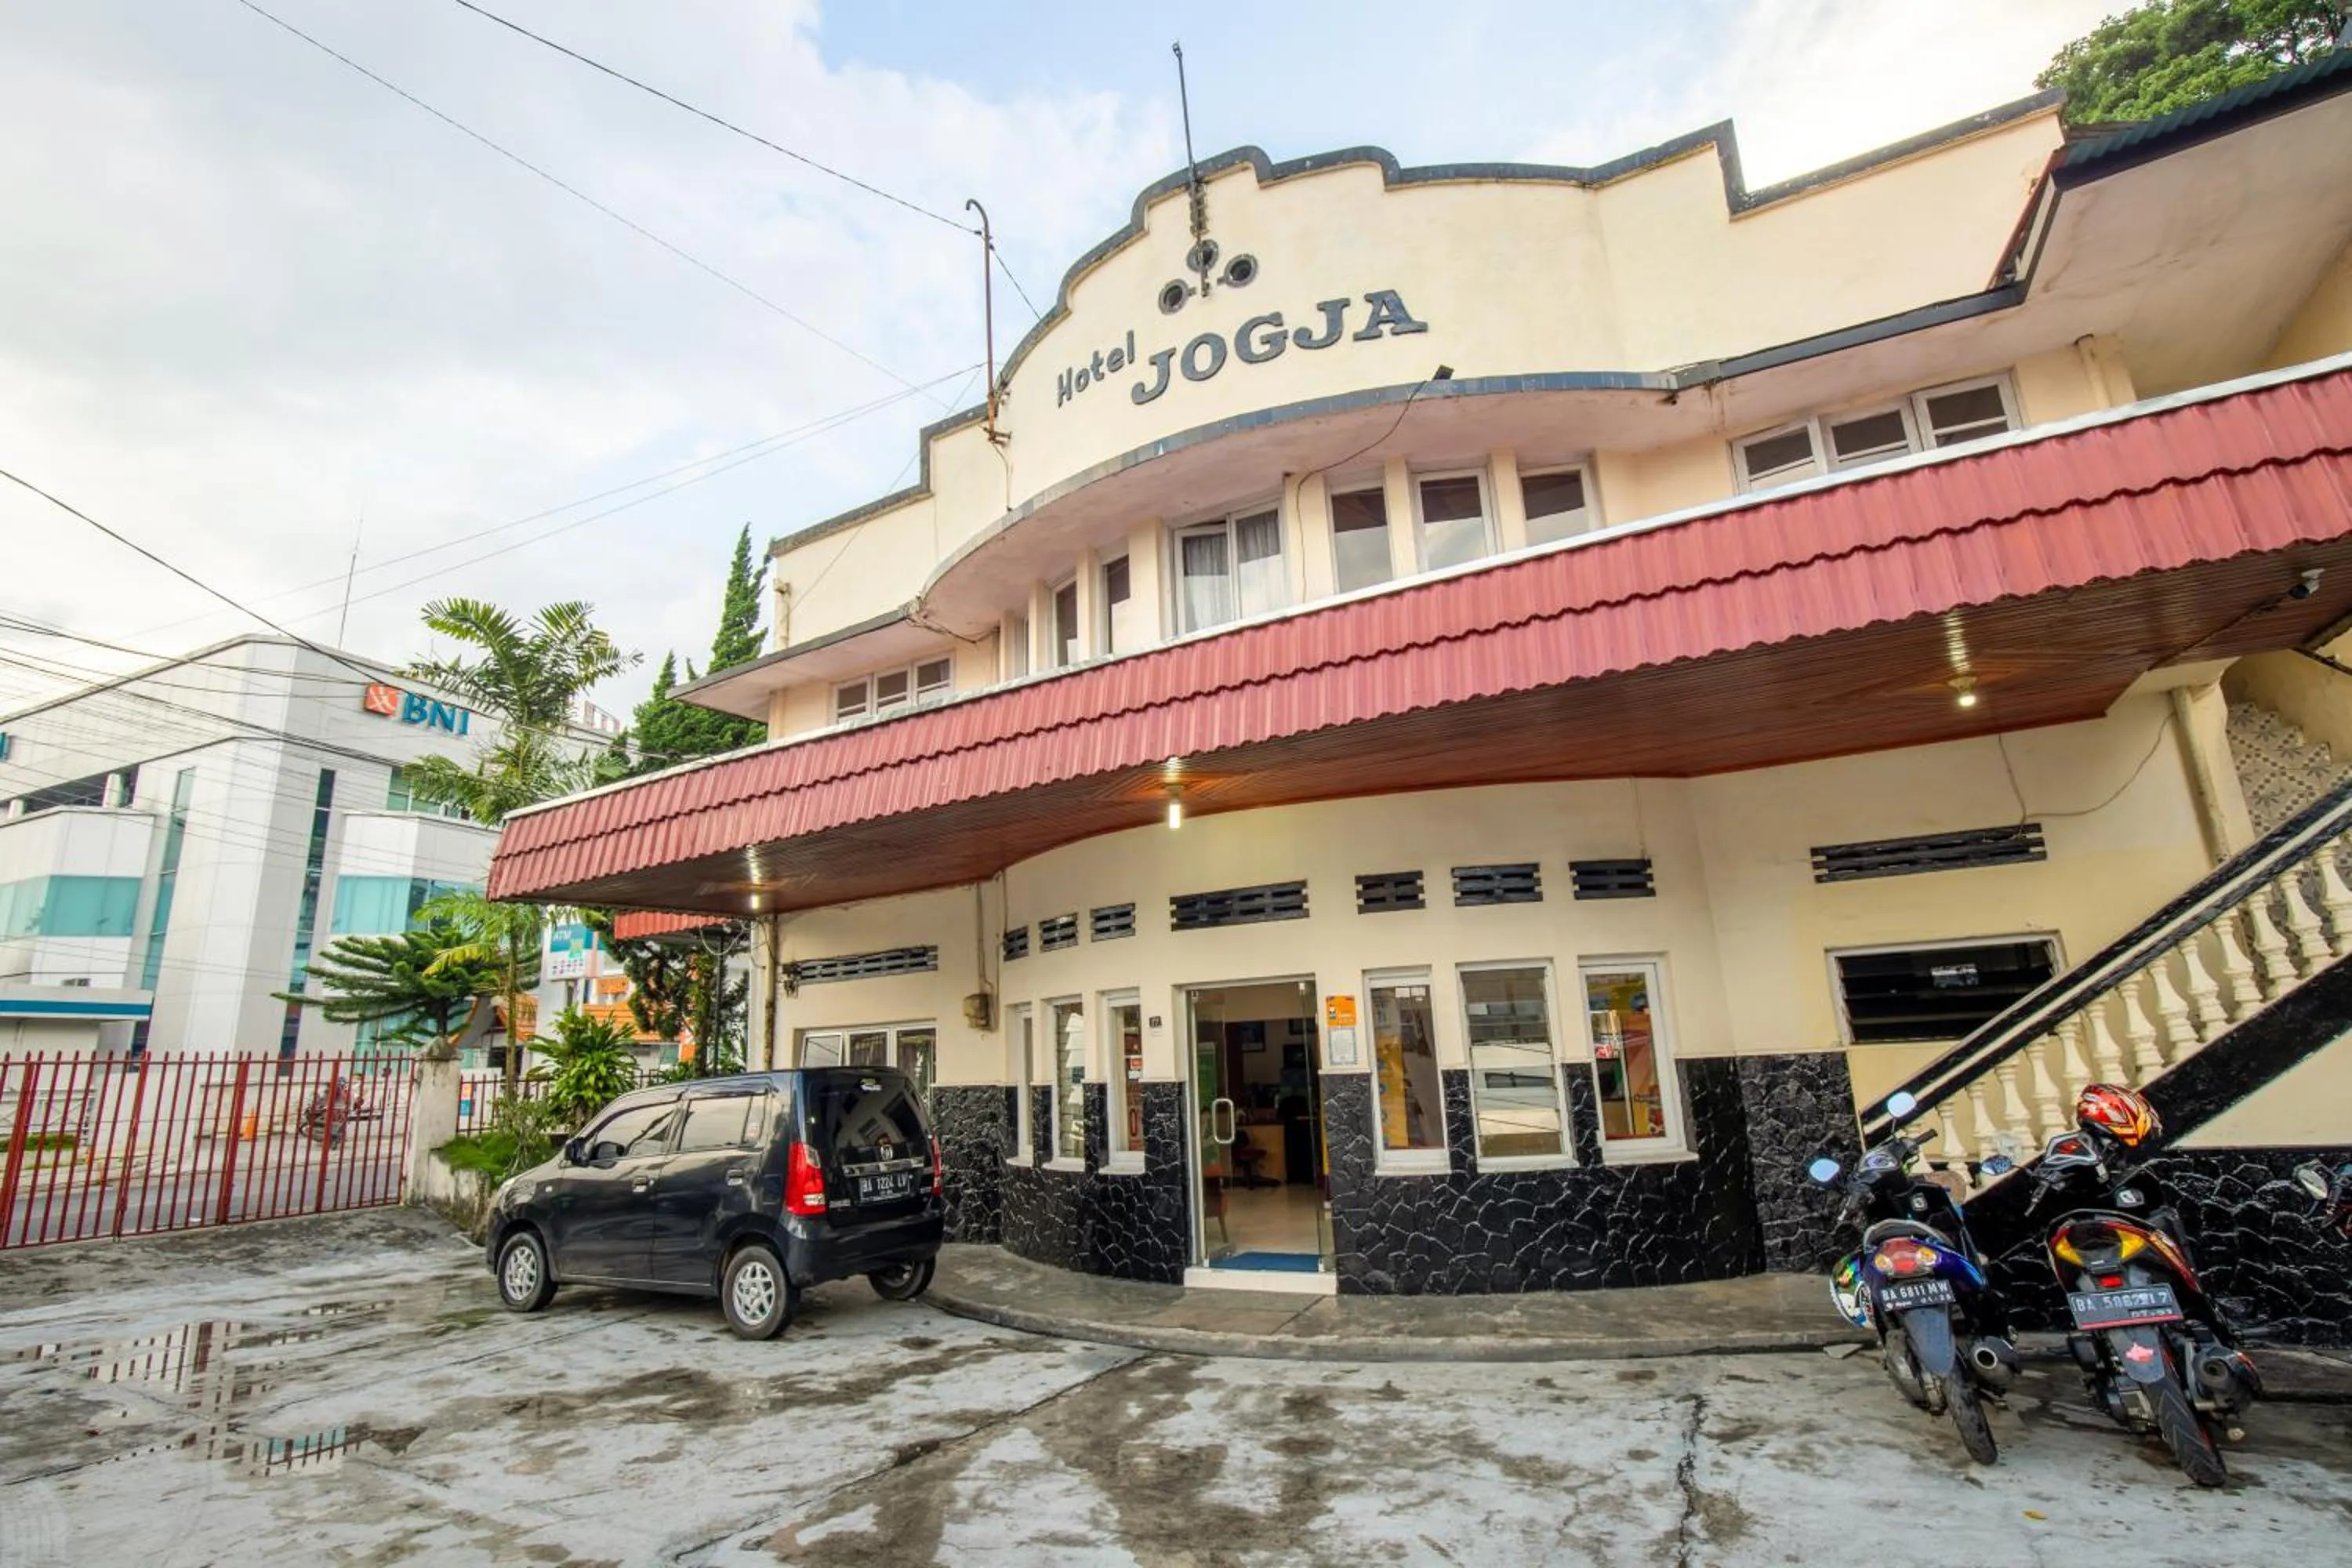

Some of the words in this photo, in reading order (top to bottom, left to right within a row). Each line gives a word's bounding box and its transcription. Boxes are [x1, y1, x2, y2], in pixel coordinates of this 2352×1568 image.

[1056, 330, 1134, 408] Hotel
[1131, 289, 1428, 405] JOGJA
[401, 691, 470, 735] BNI
[1881, 1289, 1898, 1301] BA
[2075, 1298, 2096, 1312] BA
